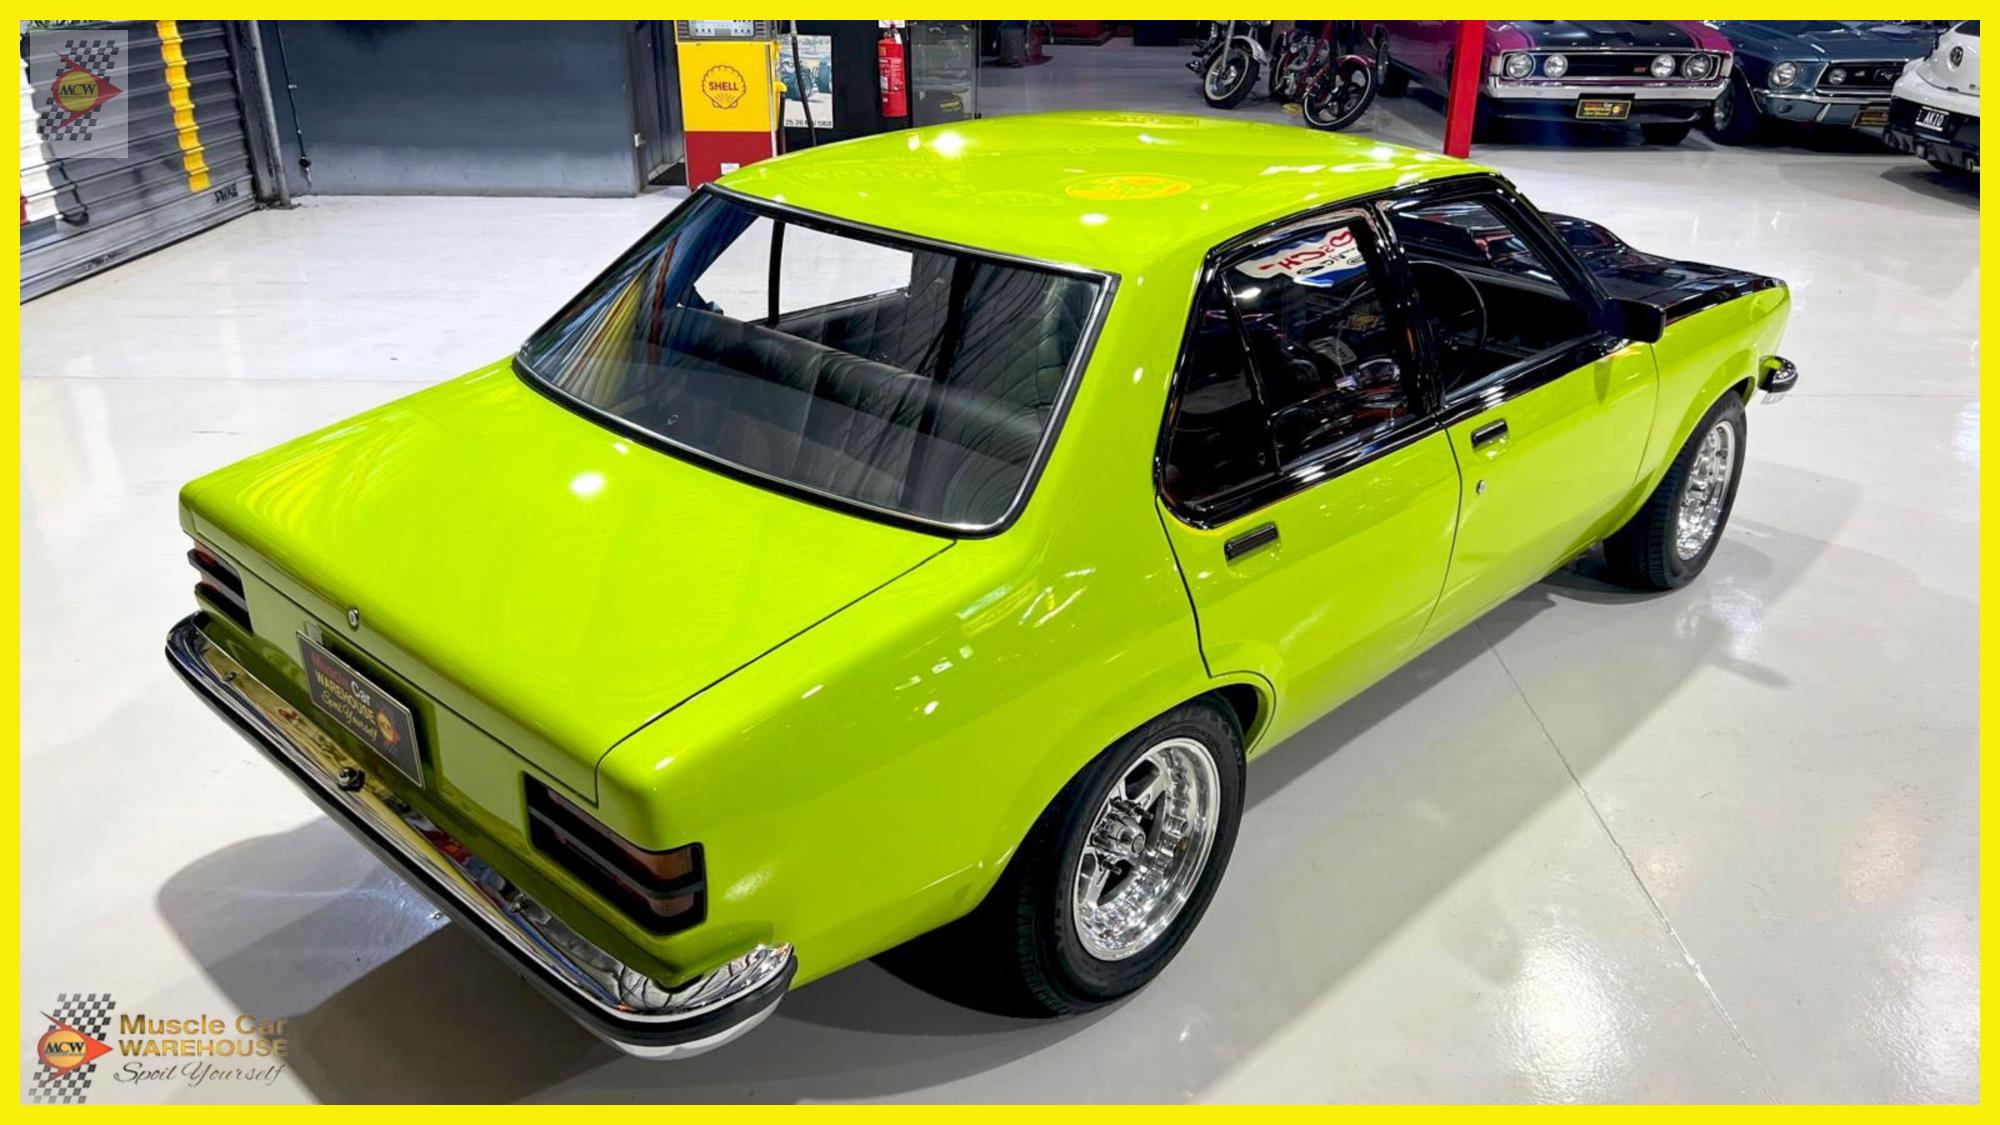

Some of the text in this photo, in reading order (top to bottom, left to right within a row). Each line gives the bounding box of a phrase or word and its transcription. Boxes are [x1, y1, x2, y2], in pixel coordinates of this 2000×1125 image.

[709, 81, 739, 92] SHELL
[315, 669, 376, 725] WAREHOUSE
[351, 681, 371, 705] Car
